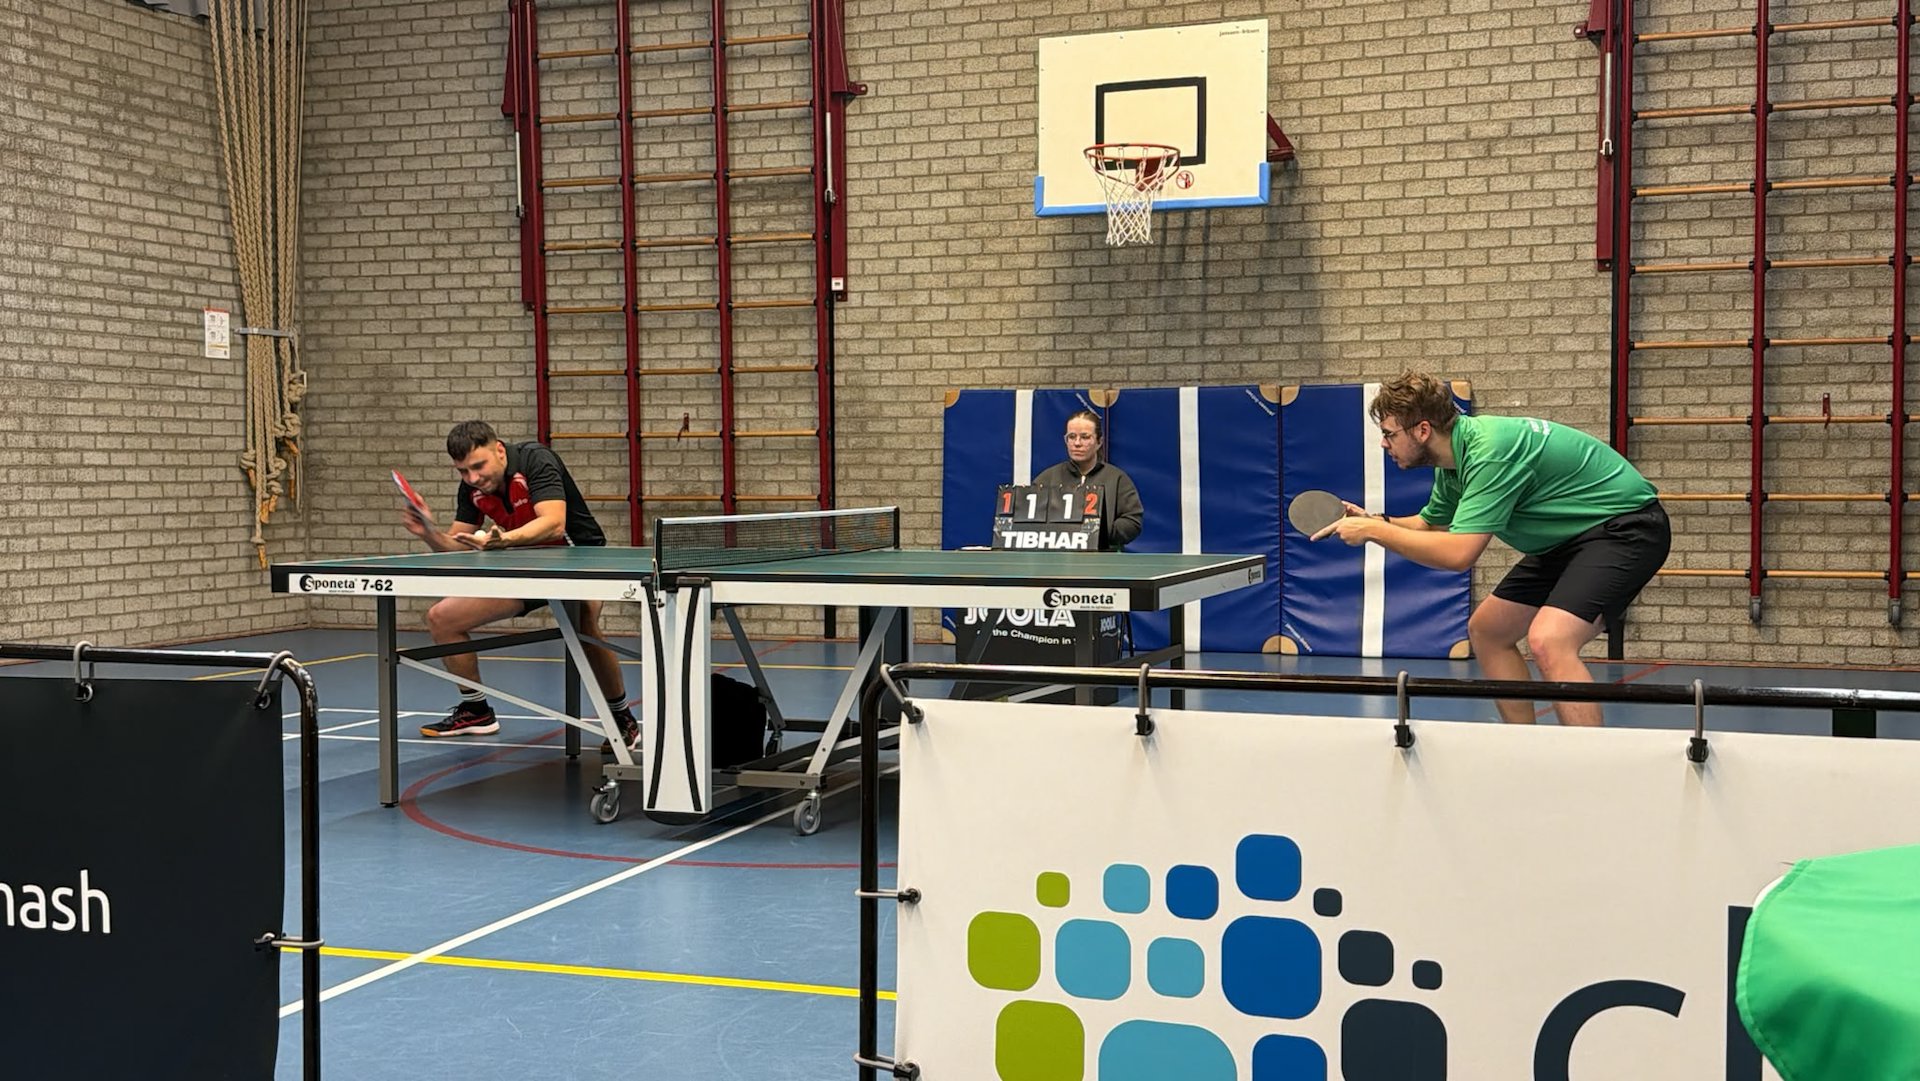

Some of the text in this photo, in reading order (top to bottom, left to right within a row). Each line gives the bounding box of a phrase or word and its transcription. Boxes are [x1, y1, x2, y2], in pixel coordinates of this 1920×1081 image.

[1003, 492, 1098, 519] 1 1 1 2
[1001, 531, 1089, 550] TIBHAR
[300, 575, 393, 592] Sponeta 7-62
[1043, 588, 1114, 608] Sponeta
[1010, 629, 1060, 645] Champion
[1062, 637, 1071, 645] in
